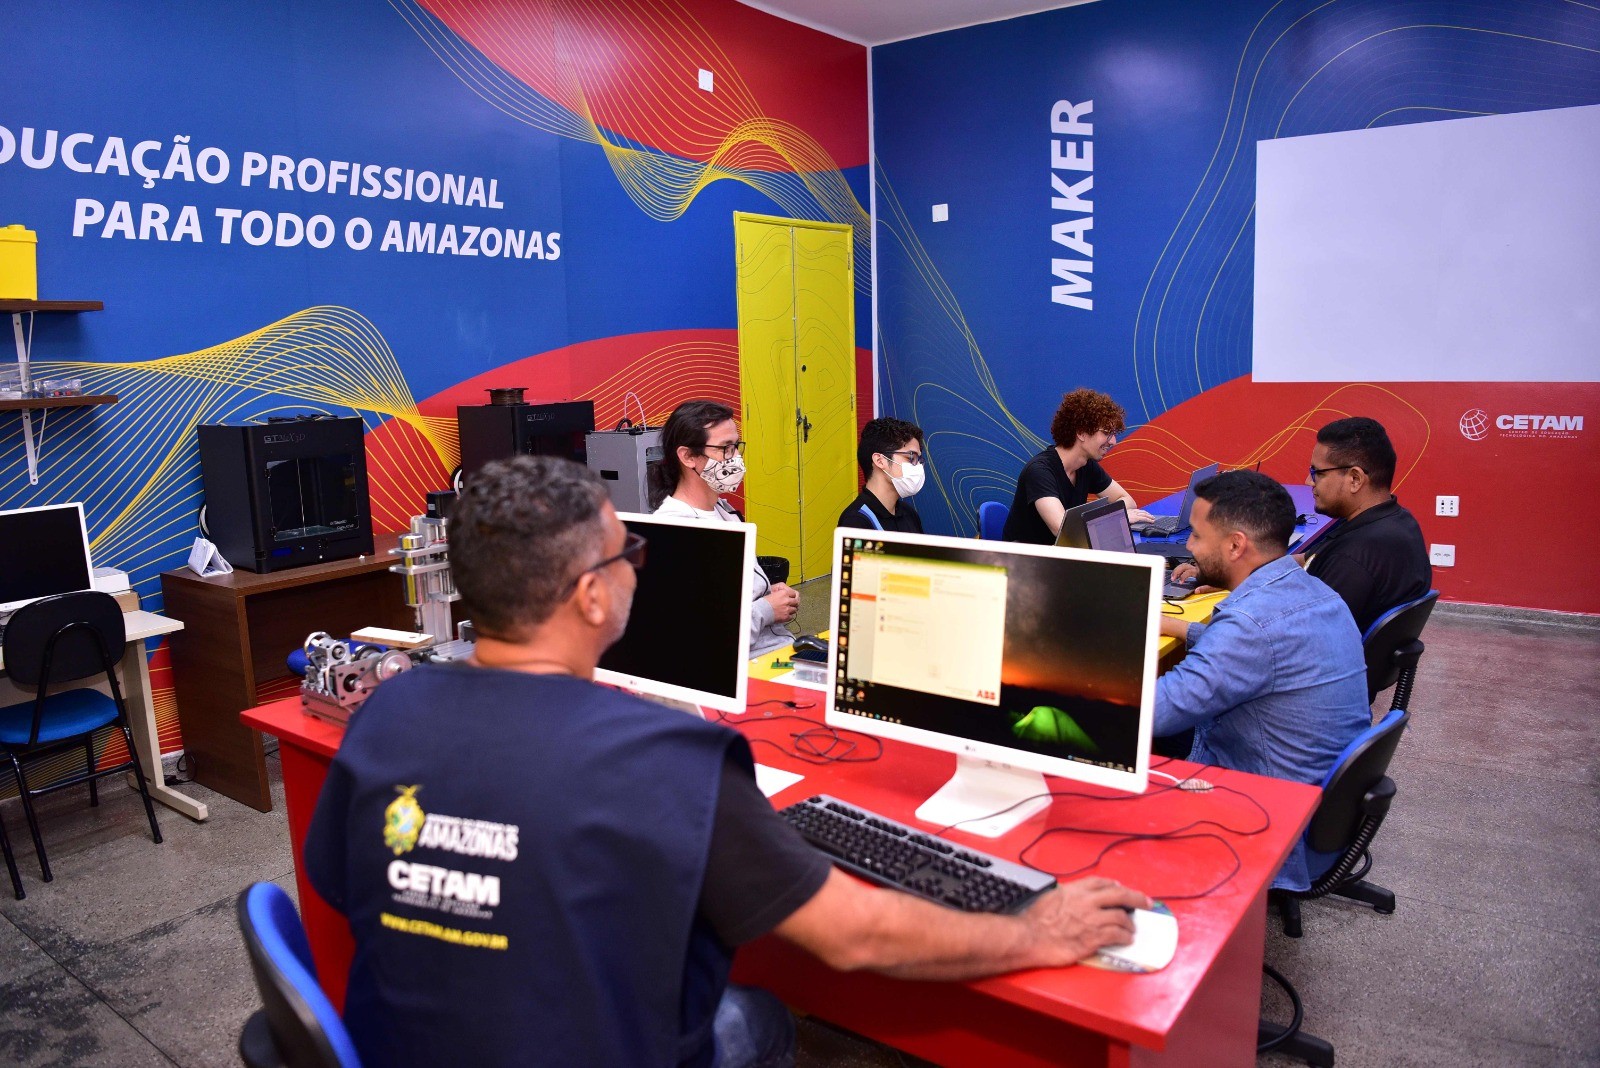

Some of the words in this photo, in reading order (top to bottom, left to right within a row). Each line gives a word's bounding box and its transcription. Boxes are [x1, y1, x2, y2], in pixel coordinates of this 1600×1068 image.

[241, 151, 504, 210] PROFISSIONAL
[1051, 99, 1094, 311] MAKER
[72, 198, 203, 242] PARA
[215, 208, 336, 249] TODO
[345, 217, 373, 250] O
[379, 220, 562, 261] AMAZONAS
[1496, 415, 1584, 431] CETAM
[976, 688, 996, 701] ABB
[418, 820, 519, 862] AMAZONAS
[388, 860, 500, 907] CETAM
